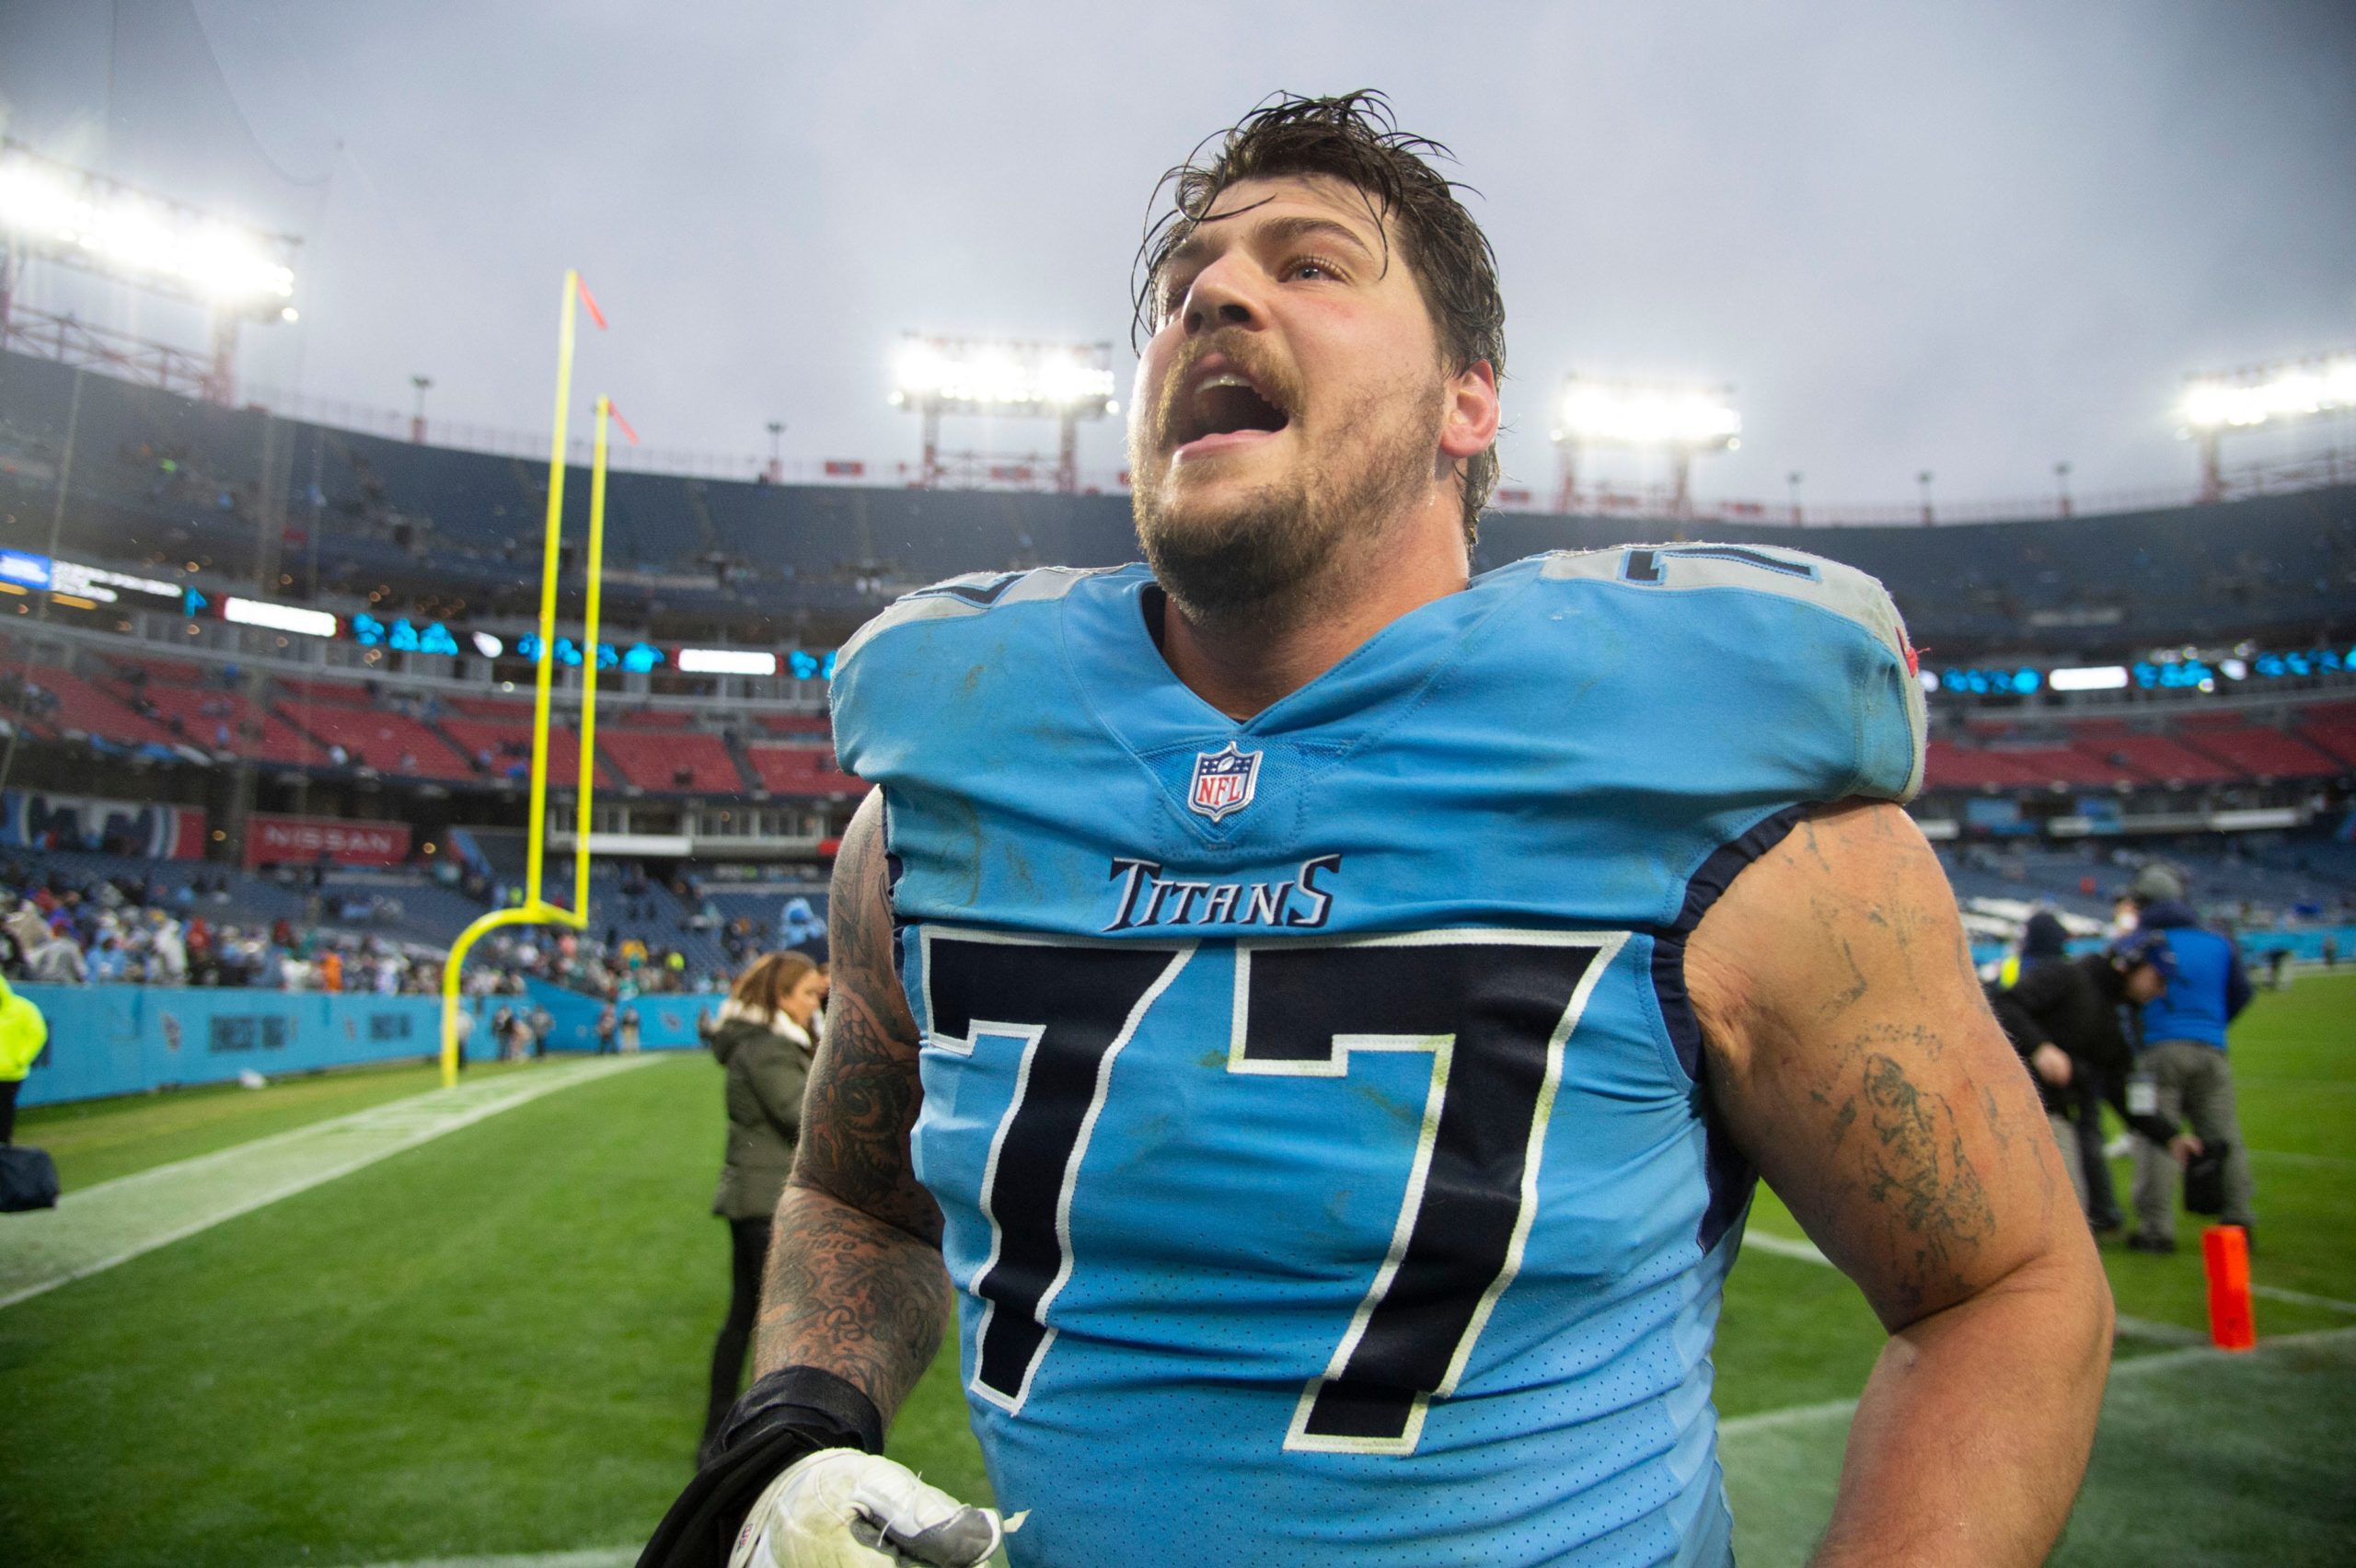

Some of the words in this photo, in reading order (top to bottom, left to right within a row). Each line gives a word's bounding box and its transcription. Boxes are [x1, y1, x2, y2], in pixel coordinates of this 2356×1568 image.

[1198, 776, 1242, 805] NFL
[265, 826, 392, 853] NISSAN
[1102, 854, 1343, 932] TITANS
[921, 926, 1632, 1456] 77
